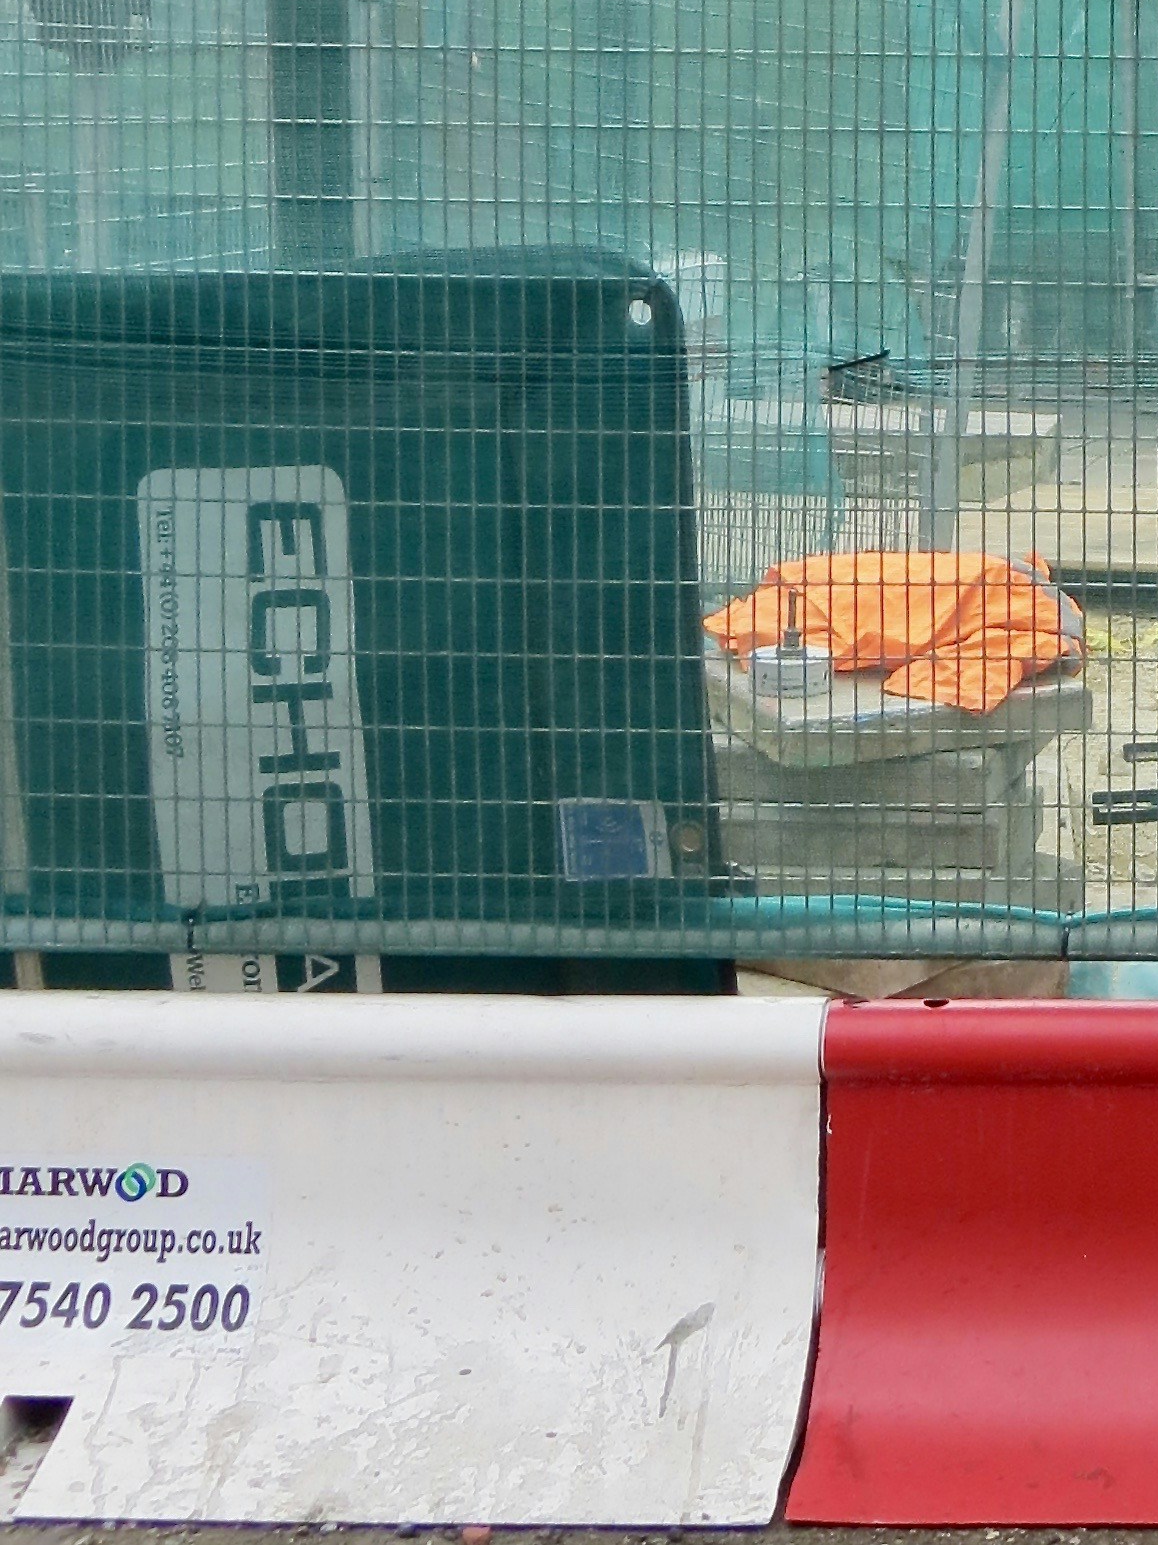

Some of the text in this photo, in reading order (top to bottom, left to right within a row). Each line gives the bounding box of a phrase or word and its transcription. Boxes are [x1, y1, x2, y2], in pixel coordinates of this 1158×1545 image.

[247, 501, 349, 872] ECHO
[0, 1218, 262, 1263] arwoodgroup.co.uk
[0, 1281, 250, 1332] 7540 2500
